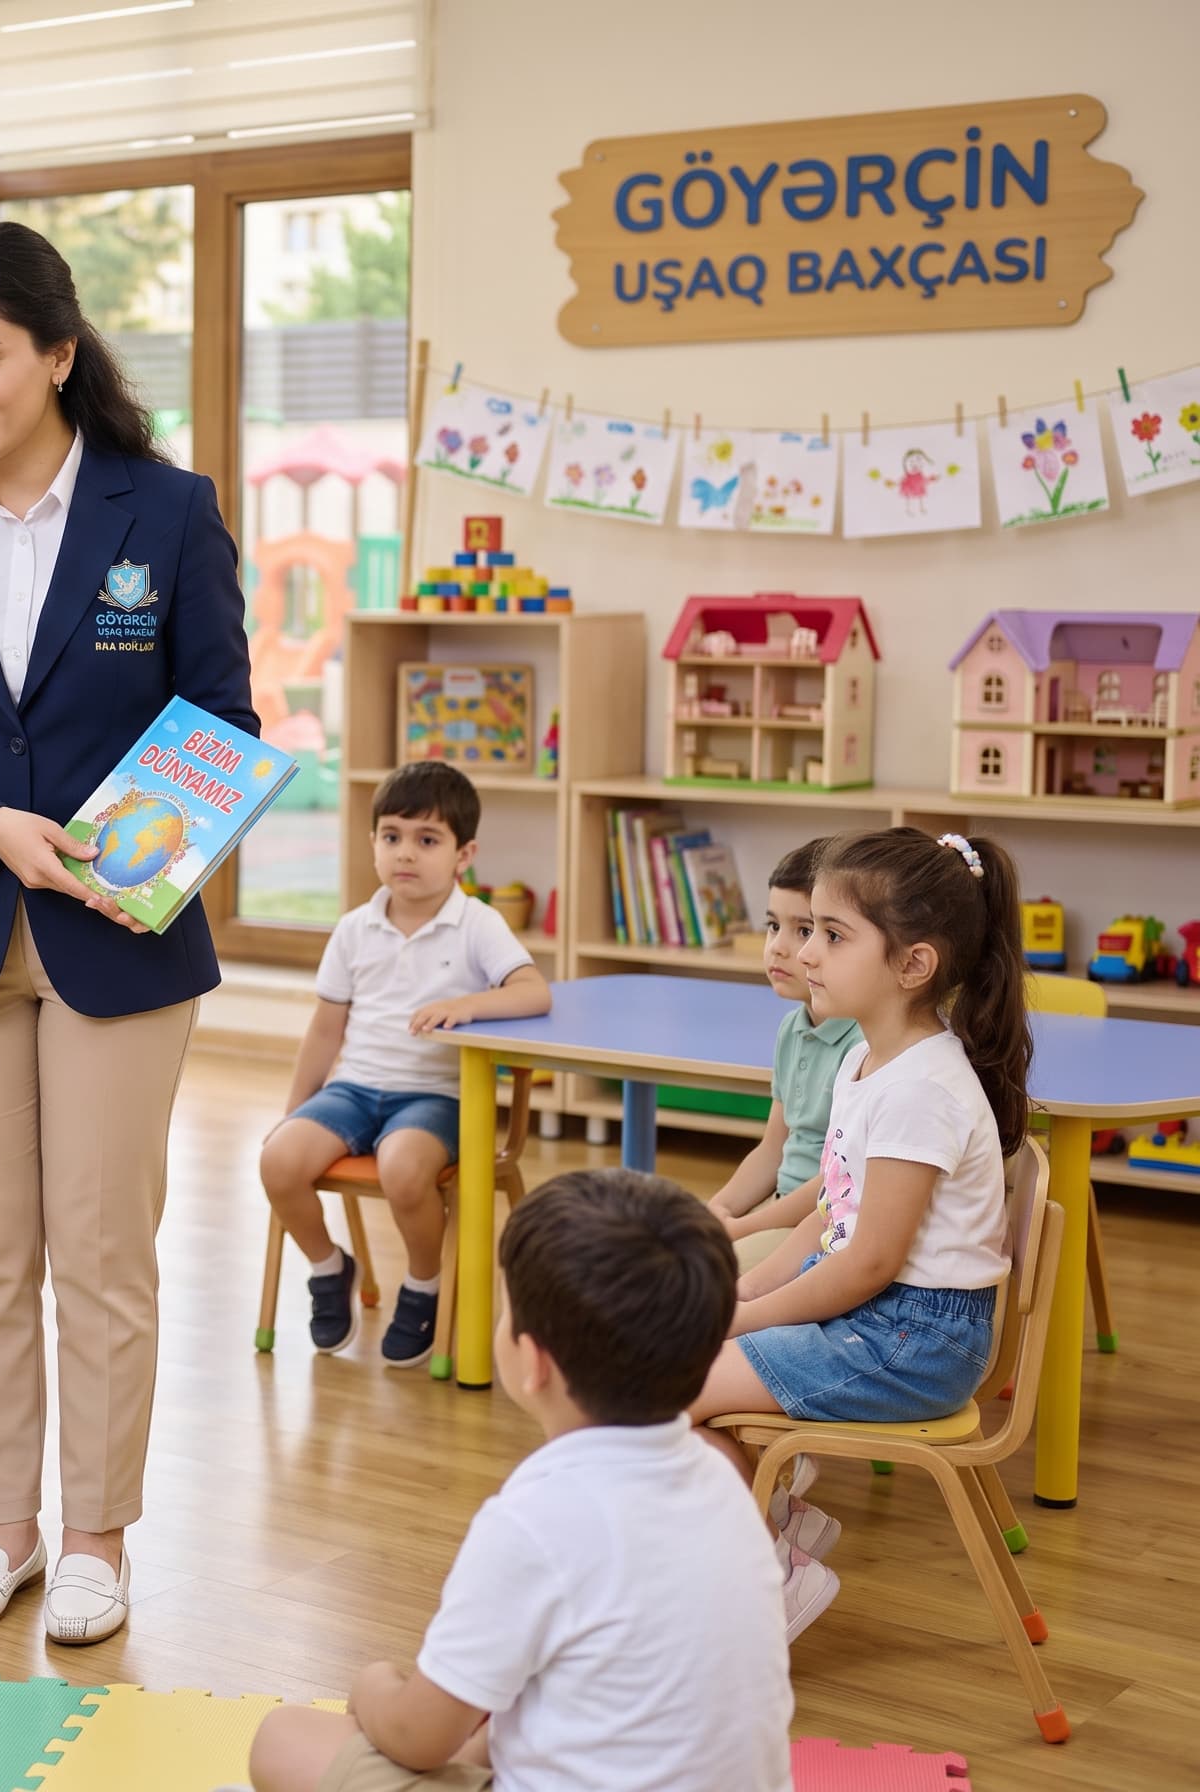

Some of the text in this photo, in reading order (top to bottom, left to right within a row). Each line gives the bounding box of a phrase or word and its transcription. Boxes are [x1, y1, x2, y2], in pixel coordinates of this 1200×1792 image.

[613, 126, 1050, 233] GÖYƏRÇİN
[613, 236, 1047, 311] UŞAQ BAXÇASI
[138, 744, 245, 815] DÜNYAMIZ
[182, 729, 244, 775] BİZİM
